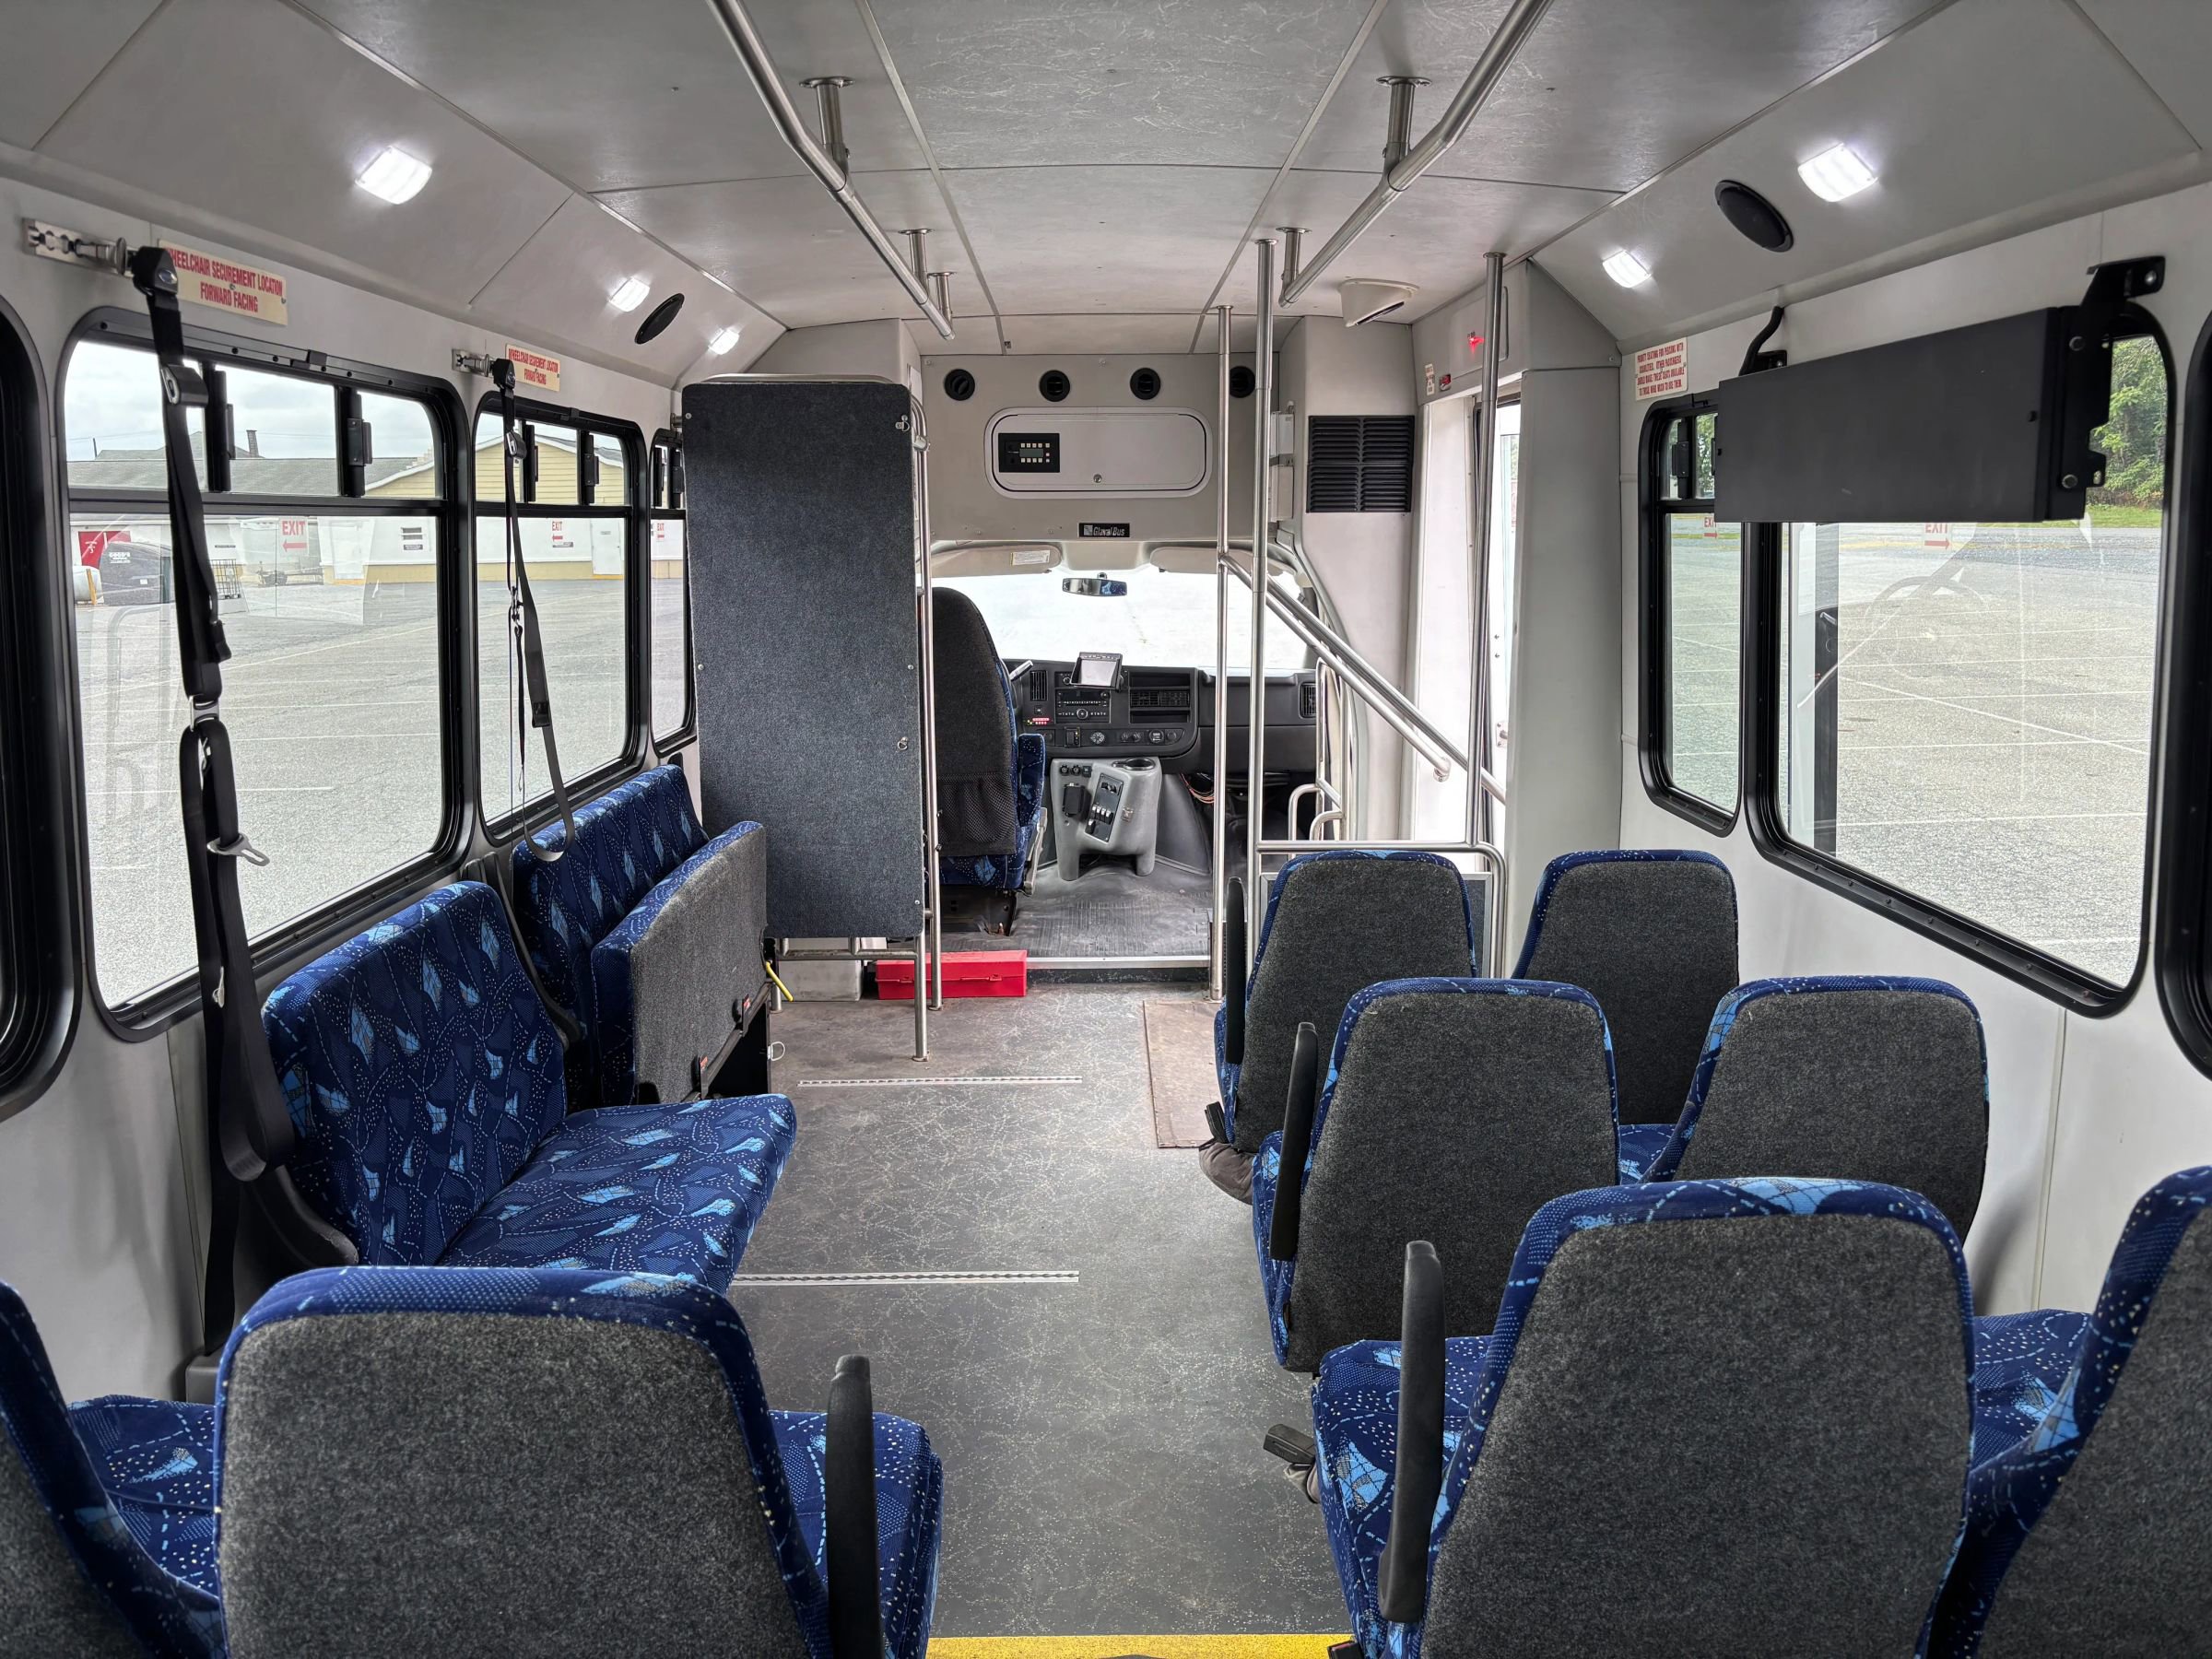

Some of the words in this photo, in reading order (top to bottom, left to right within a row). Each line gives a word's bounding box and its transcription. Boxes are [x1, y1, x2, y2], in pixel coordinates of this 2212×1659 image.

[212, 260, 256, 288] SECUREMENT
[257, 274, 283, 297] LOCATION
[200, 282, 232, 306] FORWARD
[233, 290, 258, 312] FACING
[282, 520, 306, 535] EXIT
[552, 521, 563, 531] EXIT
[1093, 526, 1112, 536] Glaval
[1112, 526, 1125, 536] Bus
